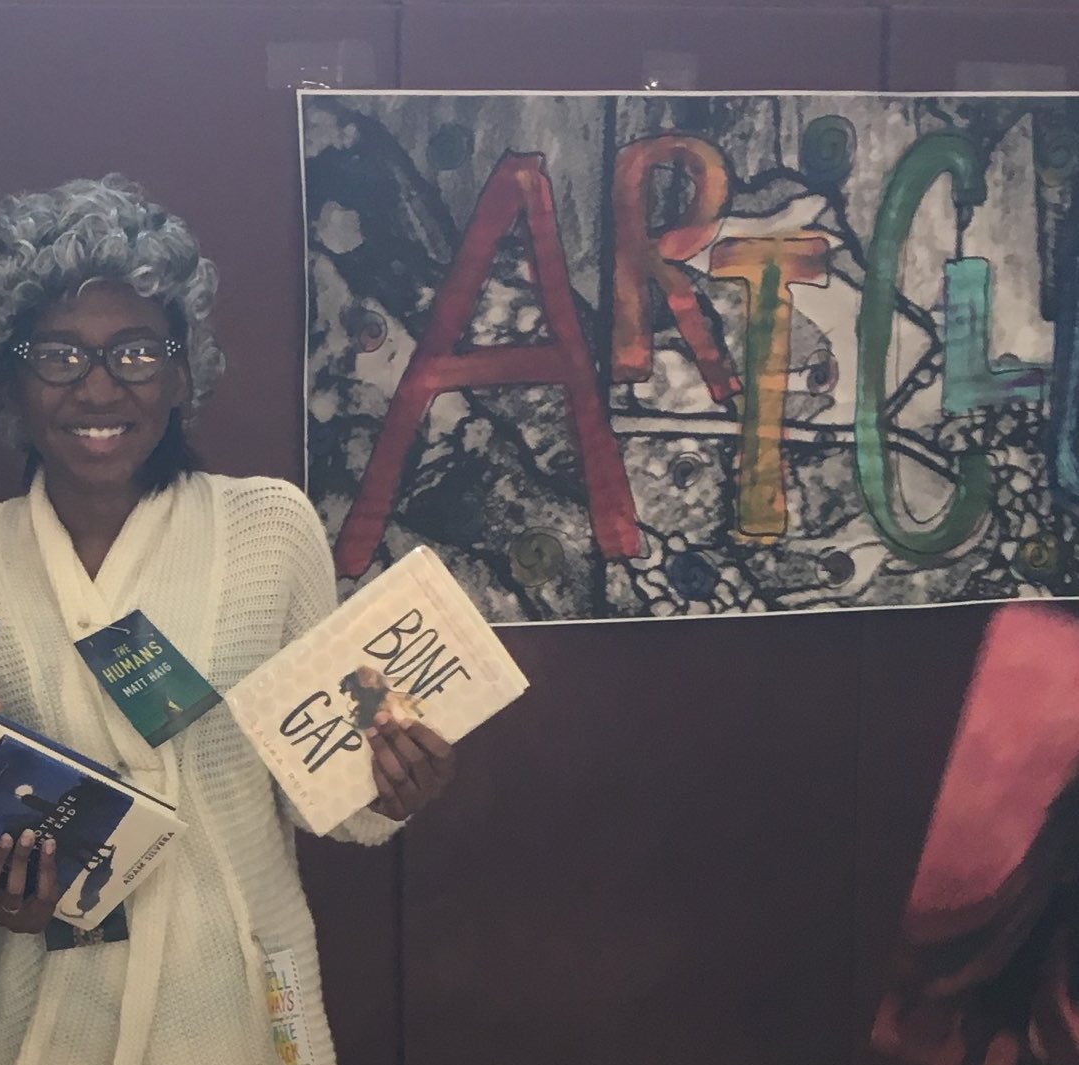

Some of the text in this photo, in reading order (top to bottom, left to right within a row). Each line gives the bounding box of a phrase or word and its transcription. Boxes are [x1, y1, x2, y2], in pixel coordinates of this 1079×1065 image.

[334, 133, 832, 578] ART
[101, 640, 164, 684] HUMANS
[112, 643, 132, 658] THE
[362, 607, 472, 703] BONE
[122, 661, 172, 698] MATT HAIG
[279, 690, 364, 774] GAP
[55, 808, 76, 830] END
[56, 795, 77, 813] DIE
[122, 861, 146, 886] ADAM
[144, 831, 176, 862] SILVERA
